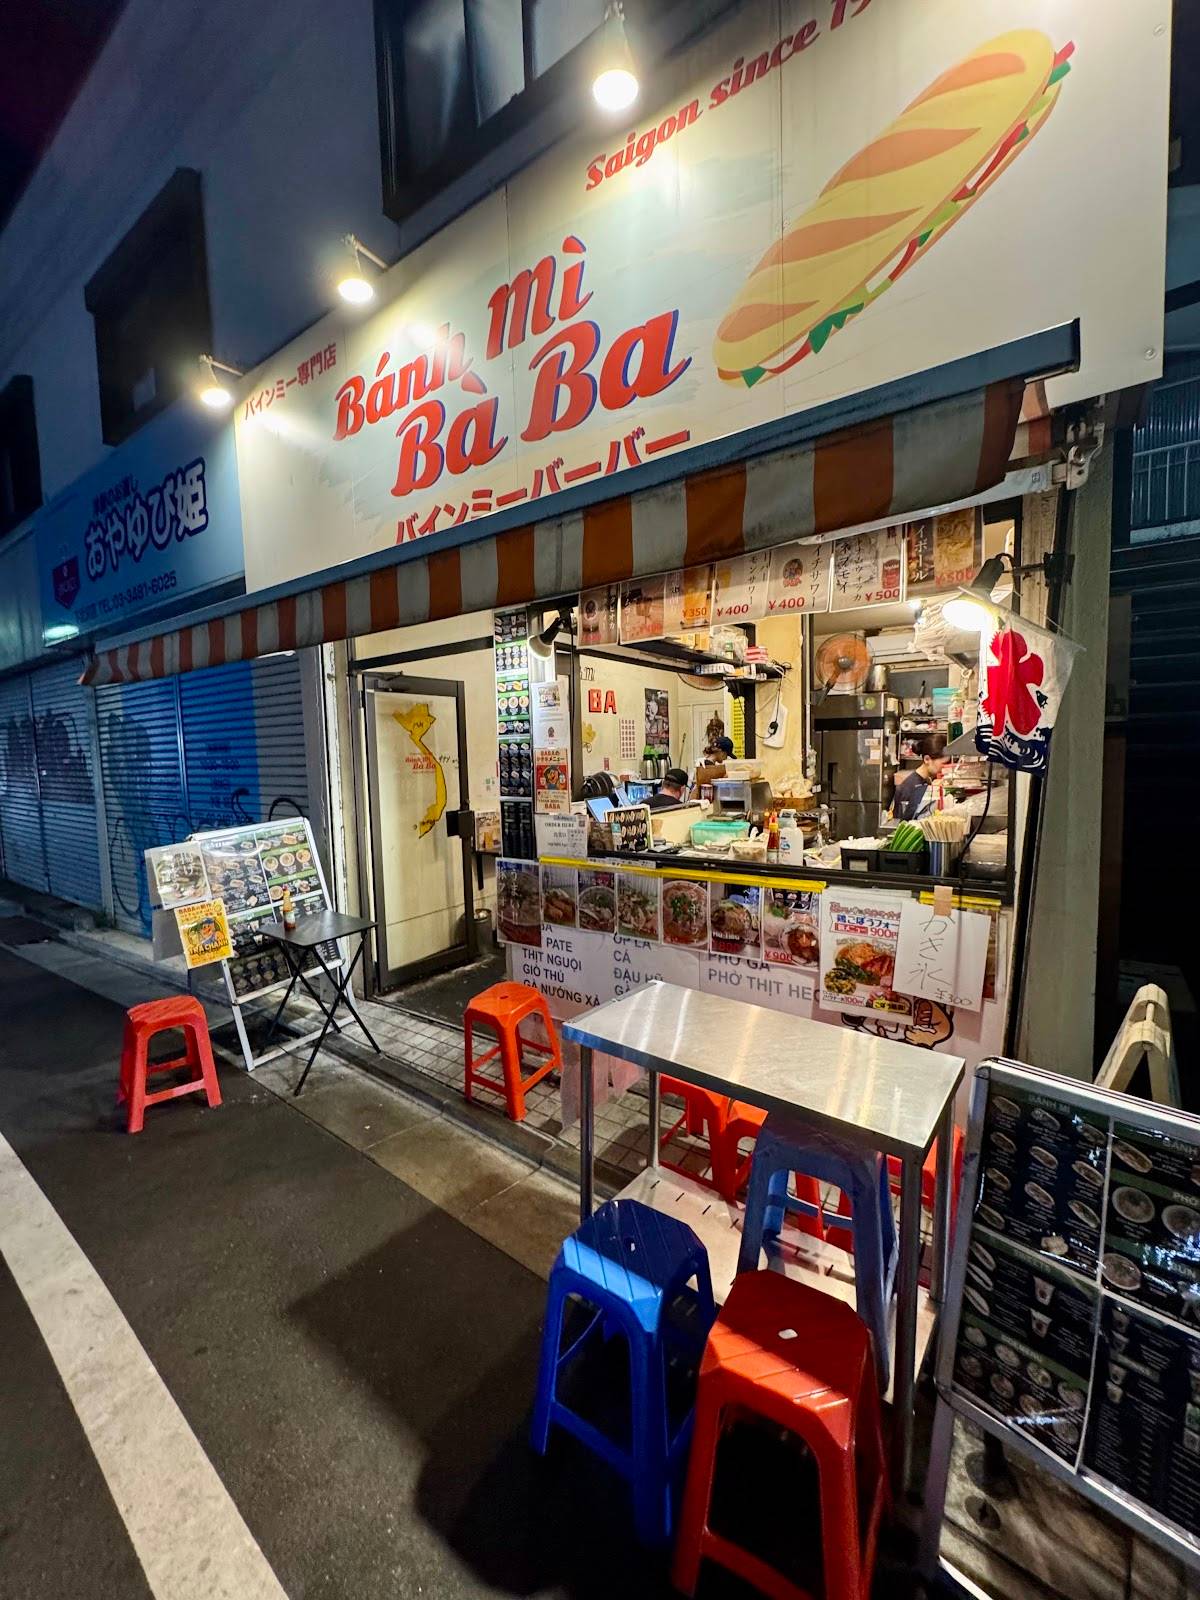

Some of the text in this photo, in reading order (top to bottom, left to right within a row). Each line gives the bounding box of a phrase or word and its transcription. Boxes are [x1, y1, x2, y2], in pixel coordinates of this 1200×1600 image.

[586, 97, 704, 192] Saigon
[709, 19, 821, 109] since
[244, 342, 337, 421] バインミー専門店
[331, 324, 474, 441] Bánh
[521, 308, 693, 444] Ba
[84, 456, 209, 582] おやゆび姫
[682, 607, 707, 618] ¥350
[716, 603, 749, 617] ¥400
[768, 597, 806, 611] ¥400
[865, 588, 900, 602] ¥500
[546, 937, 573, 952] PATE
[907, 914, 956, 990] かき氷
